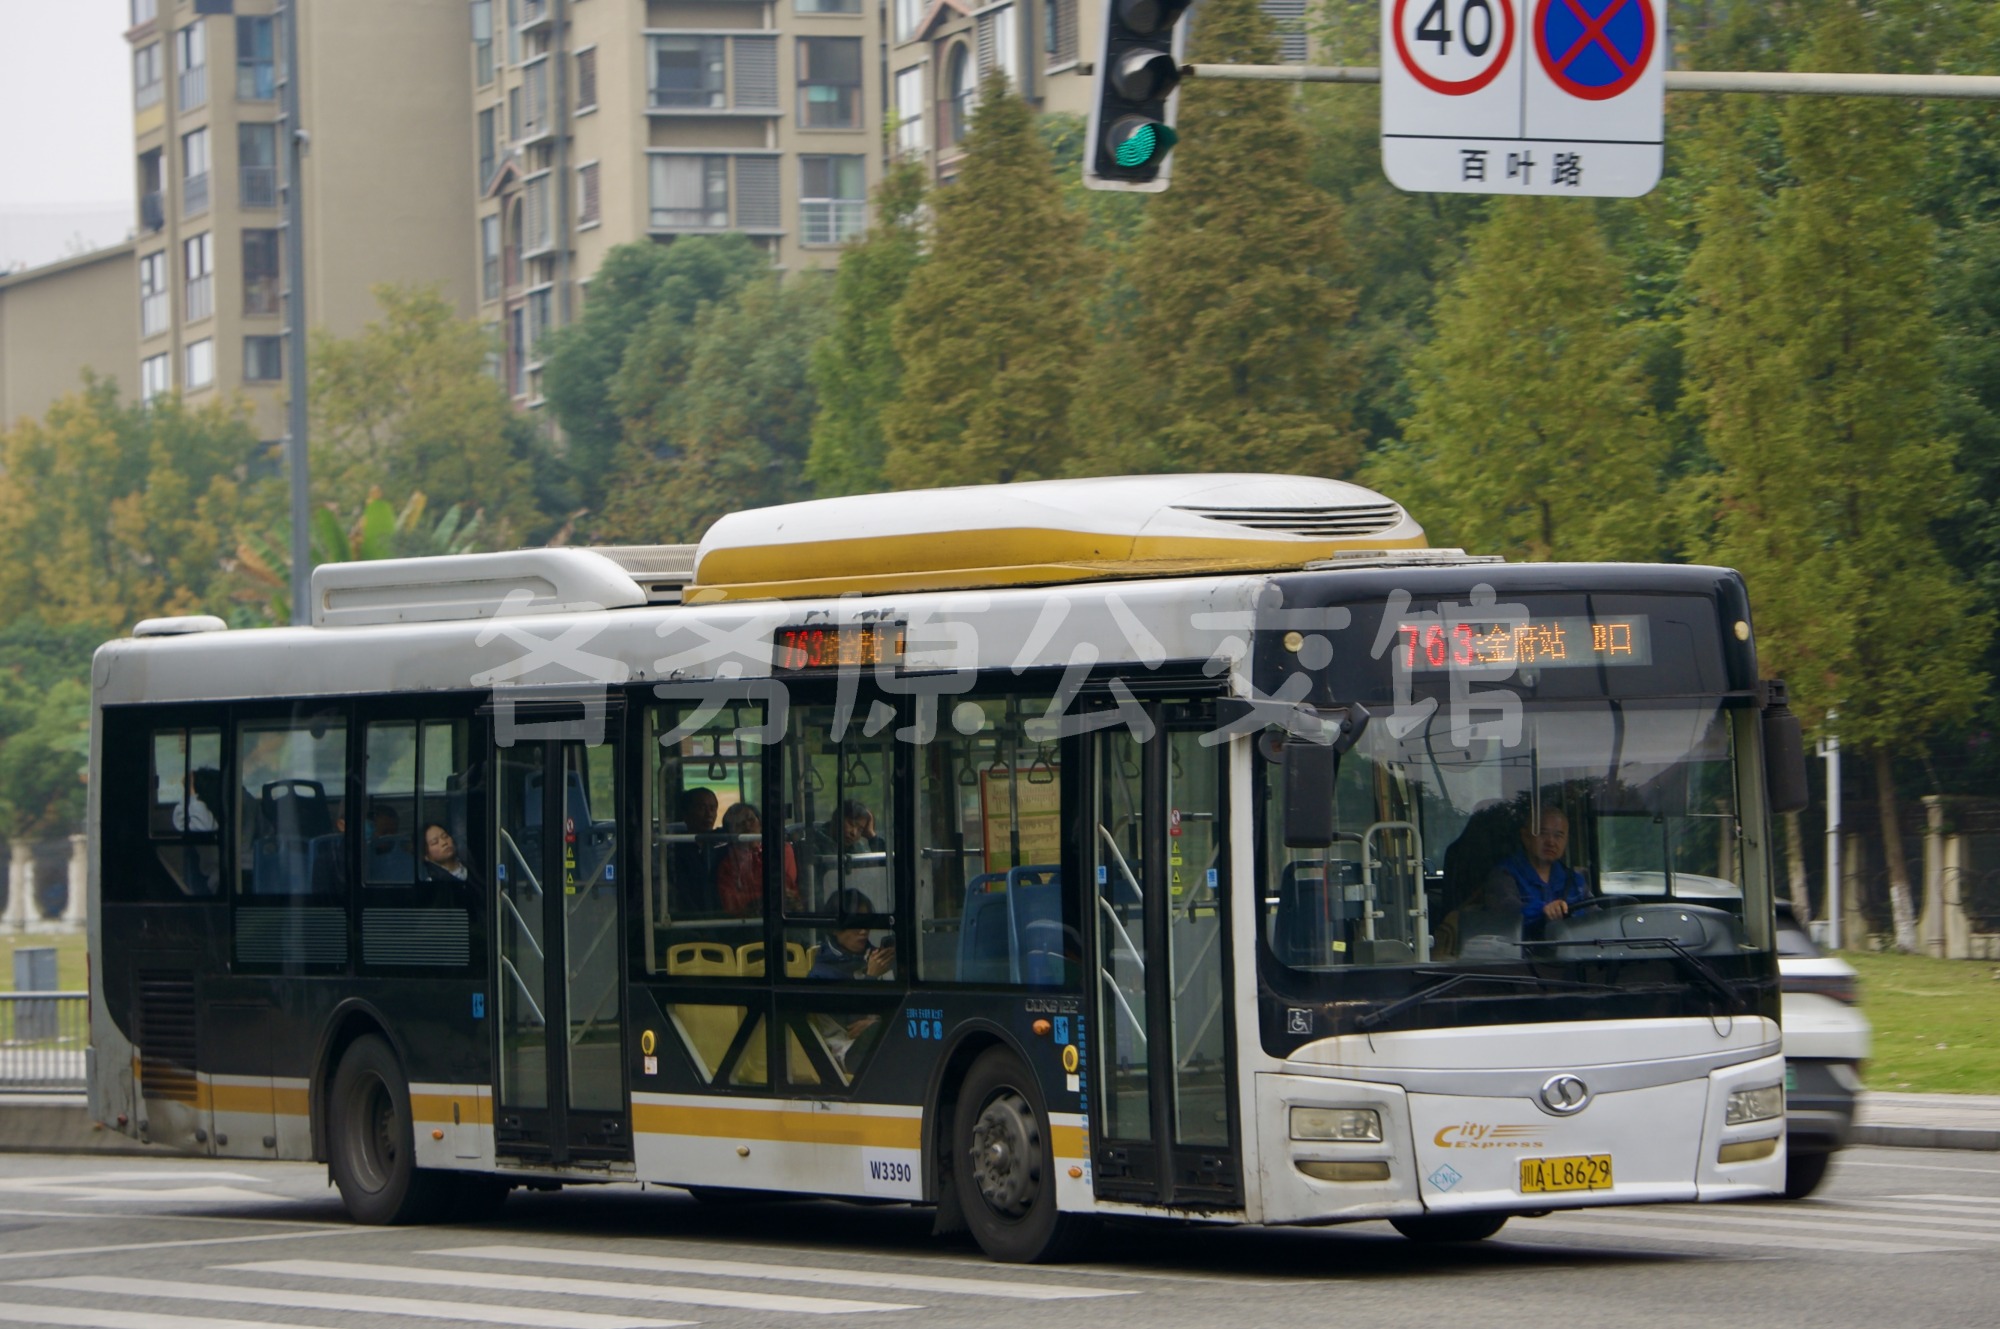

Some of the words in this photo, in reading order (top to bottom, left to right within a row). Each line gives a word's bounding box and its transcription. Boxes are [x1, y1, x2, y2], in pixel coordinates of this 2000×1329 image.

[1415, 0, 1493, 57] 40
[1459, 149, 1583, 187] 百叶路
[784, 629, 824, 668] 763
[1399, 623, 1475, 667] 763
[1433, 1121, 1491, 1148] City
[1454, 1141, 1545, 1149] Express
[870, 1160, 912, 1182] W3390
[1434, 1172, 1456, 1186] CNG
